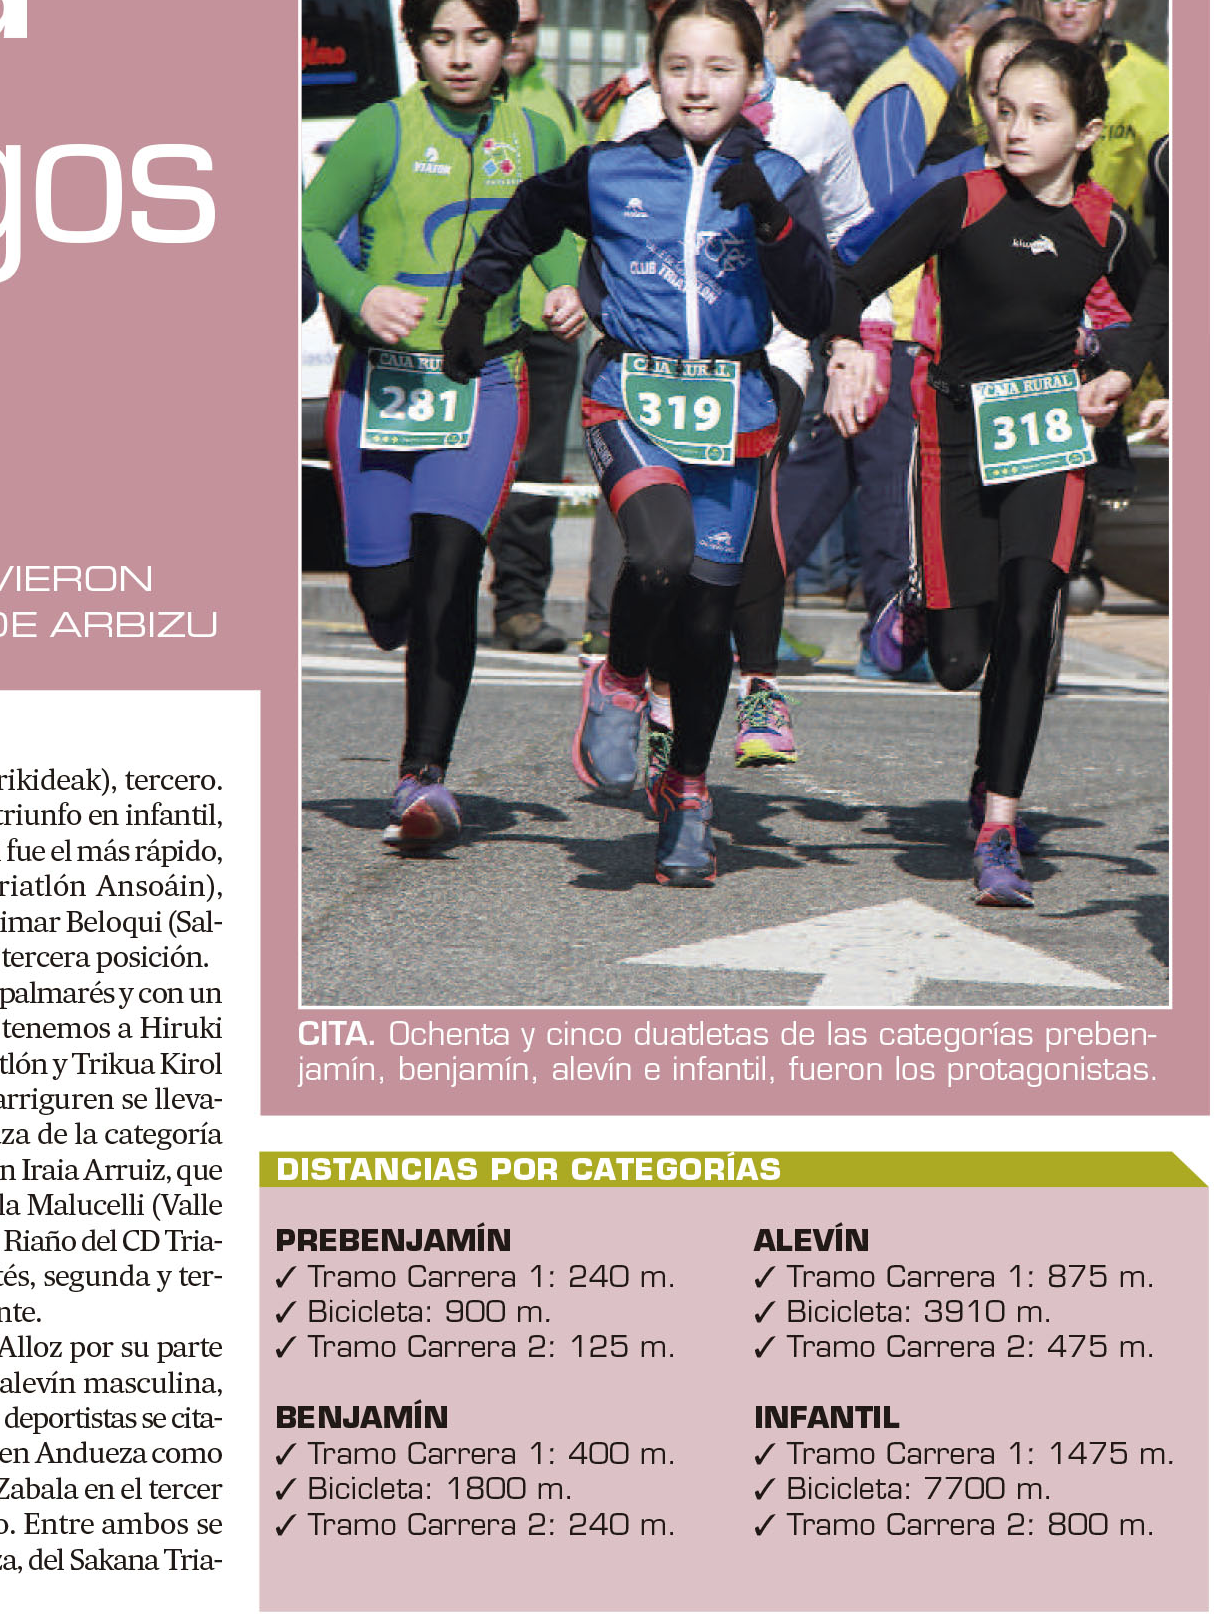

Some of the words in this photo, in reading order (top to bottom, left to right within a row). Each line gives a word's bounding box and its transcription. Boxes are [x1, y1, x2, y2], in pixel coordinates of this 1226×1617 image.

[1023, 372, 1074, 392] RURAL
[379, 385, 458, 423] 281
[637, 391, 722, 432] 319
[993, 407, 1074, 451] 318
[49, 611, 217, 638] ARBIZU
[298, 1020, 375, 1046] CITA.
[389, 1020, 510, 1046] Ochenta
[520, 1027, 536, 1053] y
[546, 1020, 622, 1046] cinco
[634, 1020, 769, 1046] duatletas
[781, 1020, 815, 1046] de
[827, 1020, 868, 1046] las
[879, 1021, 1034, 1053] categorías
[1045, 1020, 1157, 1053] preben-
[297, 1055, 384, 1088] jamín,
[399, 1055, 537, 1088] benjamín,
[552, 1055, 631, 1081] alevín
[644, 1062, 661, 1081] e
[673, 1055, 775, 1085] infantil,
[788, 1055, 883, 1081] fueron
[895, 1055, 935, 1081] los
[947, 1055, 1156, 1088] protagonistas.
[277, 1157, 478, 1181] DISTANCIAS
[491, 1157, 558, 1181] POR
[571, 1152, 781, 1181] CATEGORÍAS
[276, 1222, 511, 1252] PREBENJAMÍN
[753, 1221, 869, 1252] ALEVÍN
[307, 1264, 396, 1288] Tramo
[407, 1264, 516, 1288] Carrera
[530, 1264, 554, 1288] 1:
[569, 1264, 630, 1288] 240
[641, 1270, 674, 1288] m.
[276, 1399, 448, 1429] BENJAMÍN
[755, 1405, 900, 1429] INFANTIL
[787, 1476, 910, 1500] Bicicleta:
[924, 1476, 1006, 1500] 7700
[1017, 1482, 1050, 1500] m.
